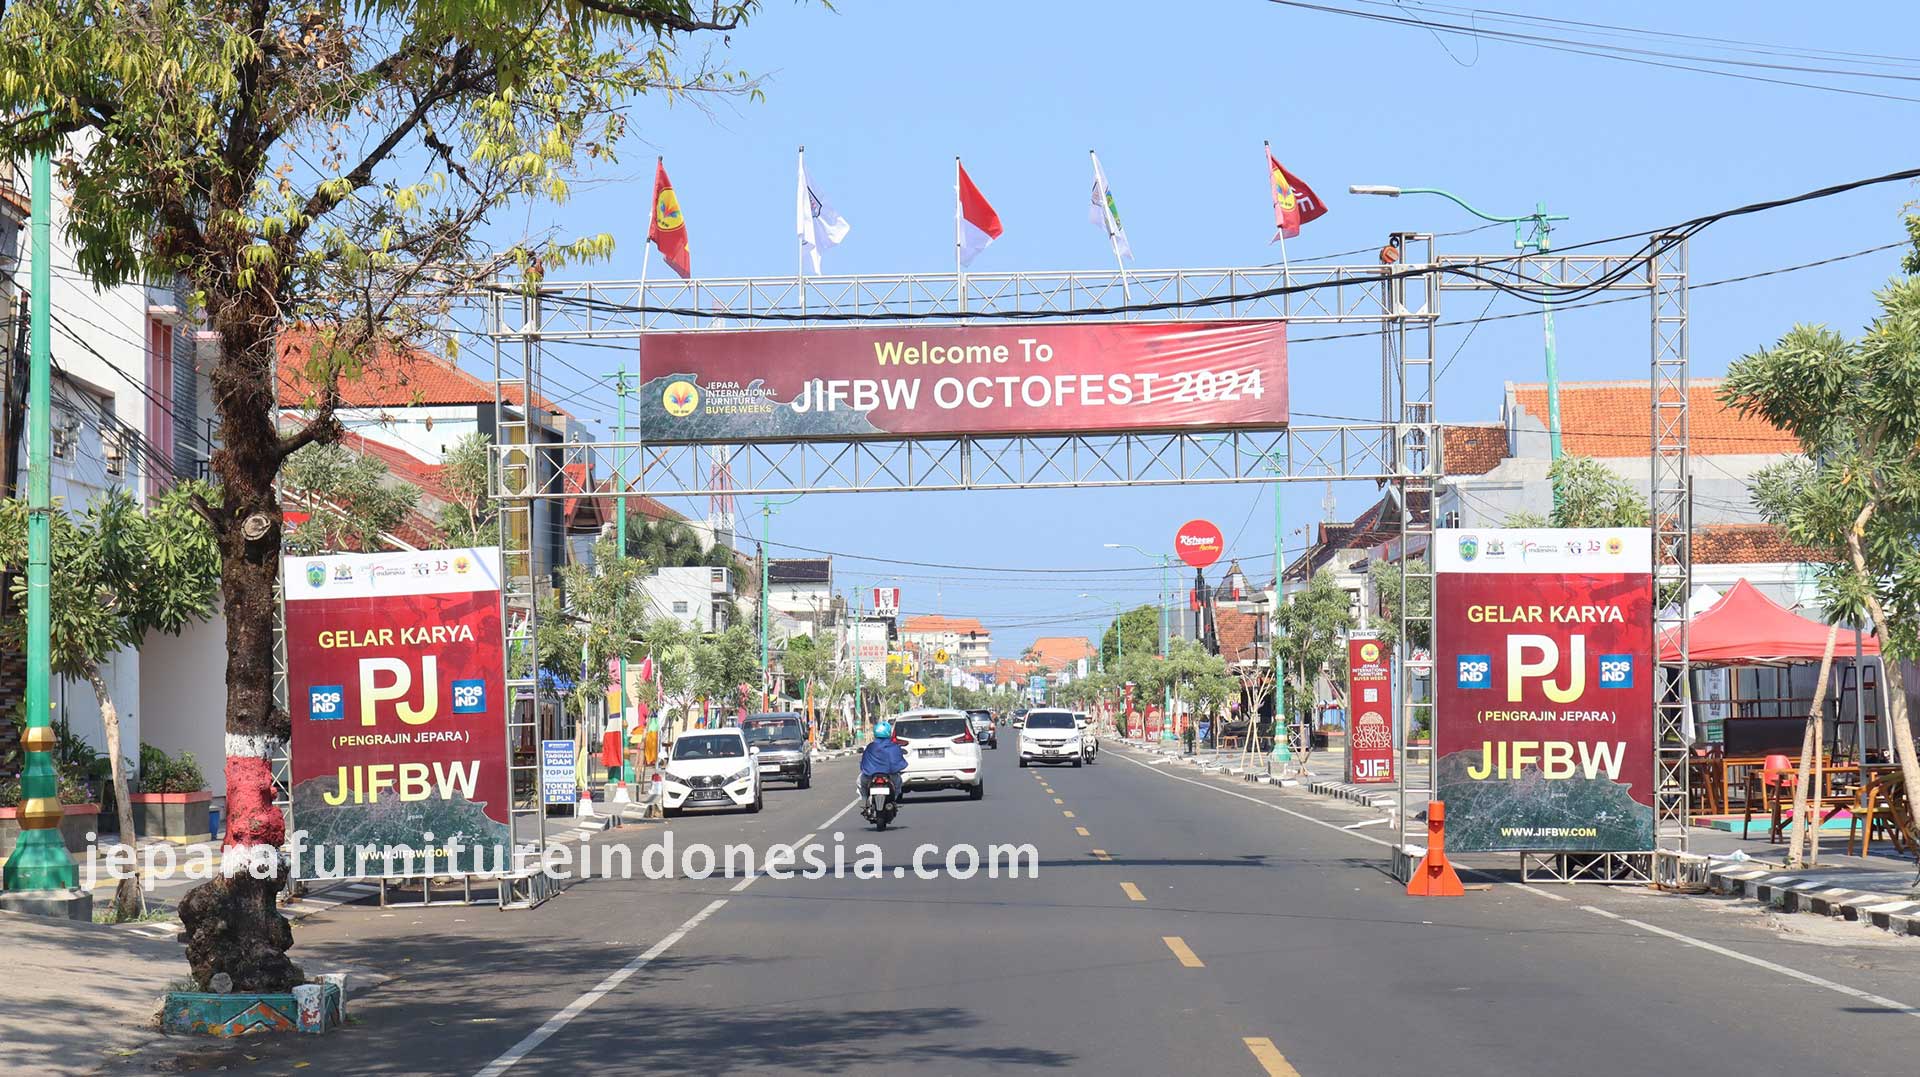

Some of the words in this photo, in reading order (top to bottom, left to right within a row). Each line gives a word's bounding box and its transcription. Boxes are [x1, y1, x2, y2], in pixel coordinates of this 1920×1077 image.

[873, 341, 1009, 365] Welcome
[1018, 338, 1053, 362] To
[705, 381, 739, 389] JEPARA
[790, 378, 921, 413] JIFBW
[933, 372, 1160, 410] OCTOFEST
[1172, 368, 1264, 403] 2024
[705, 388, 777, 398] INTERNATIONAL
[705, 397, 756, 405] FURNITURE
[705, 406, 738, 414] BUYER
[739, 405, 772, 413] WEEKS
[877, 608, 896, 616] KFC
[1467, 605, 1544, 623] GELAR
[1550, 605, 1625, 623] KARYA
[318, 628, 394, 648] GELAR
[400, 624, 474, 645] KARYA
[1459, 662, 1488, 672] POS
[1506, 634, 1586, 704] PJ
[1601, 662, 1630, 672] POS
[358, 655, 439, 727] PJ
[454, 686, 483, 697] POS
[311, 693, 341, 703] POS
[1466, 741, 1627, 780] JIFBW
[323, 760, 481, 806] JIFBW
[1501, 827, 1597, 837] WWW.JIFBW.COM
[358, 848, 453, 861] WWW.JIFBW.COM
